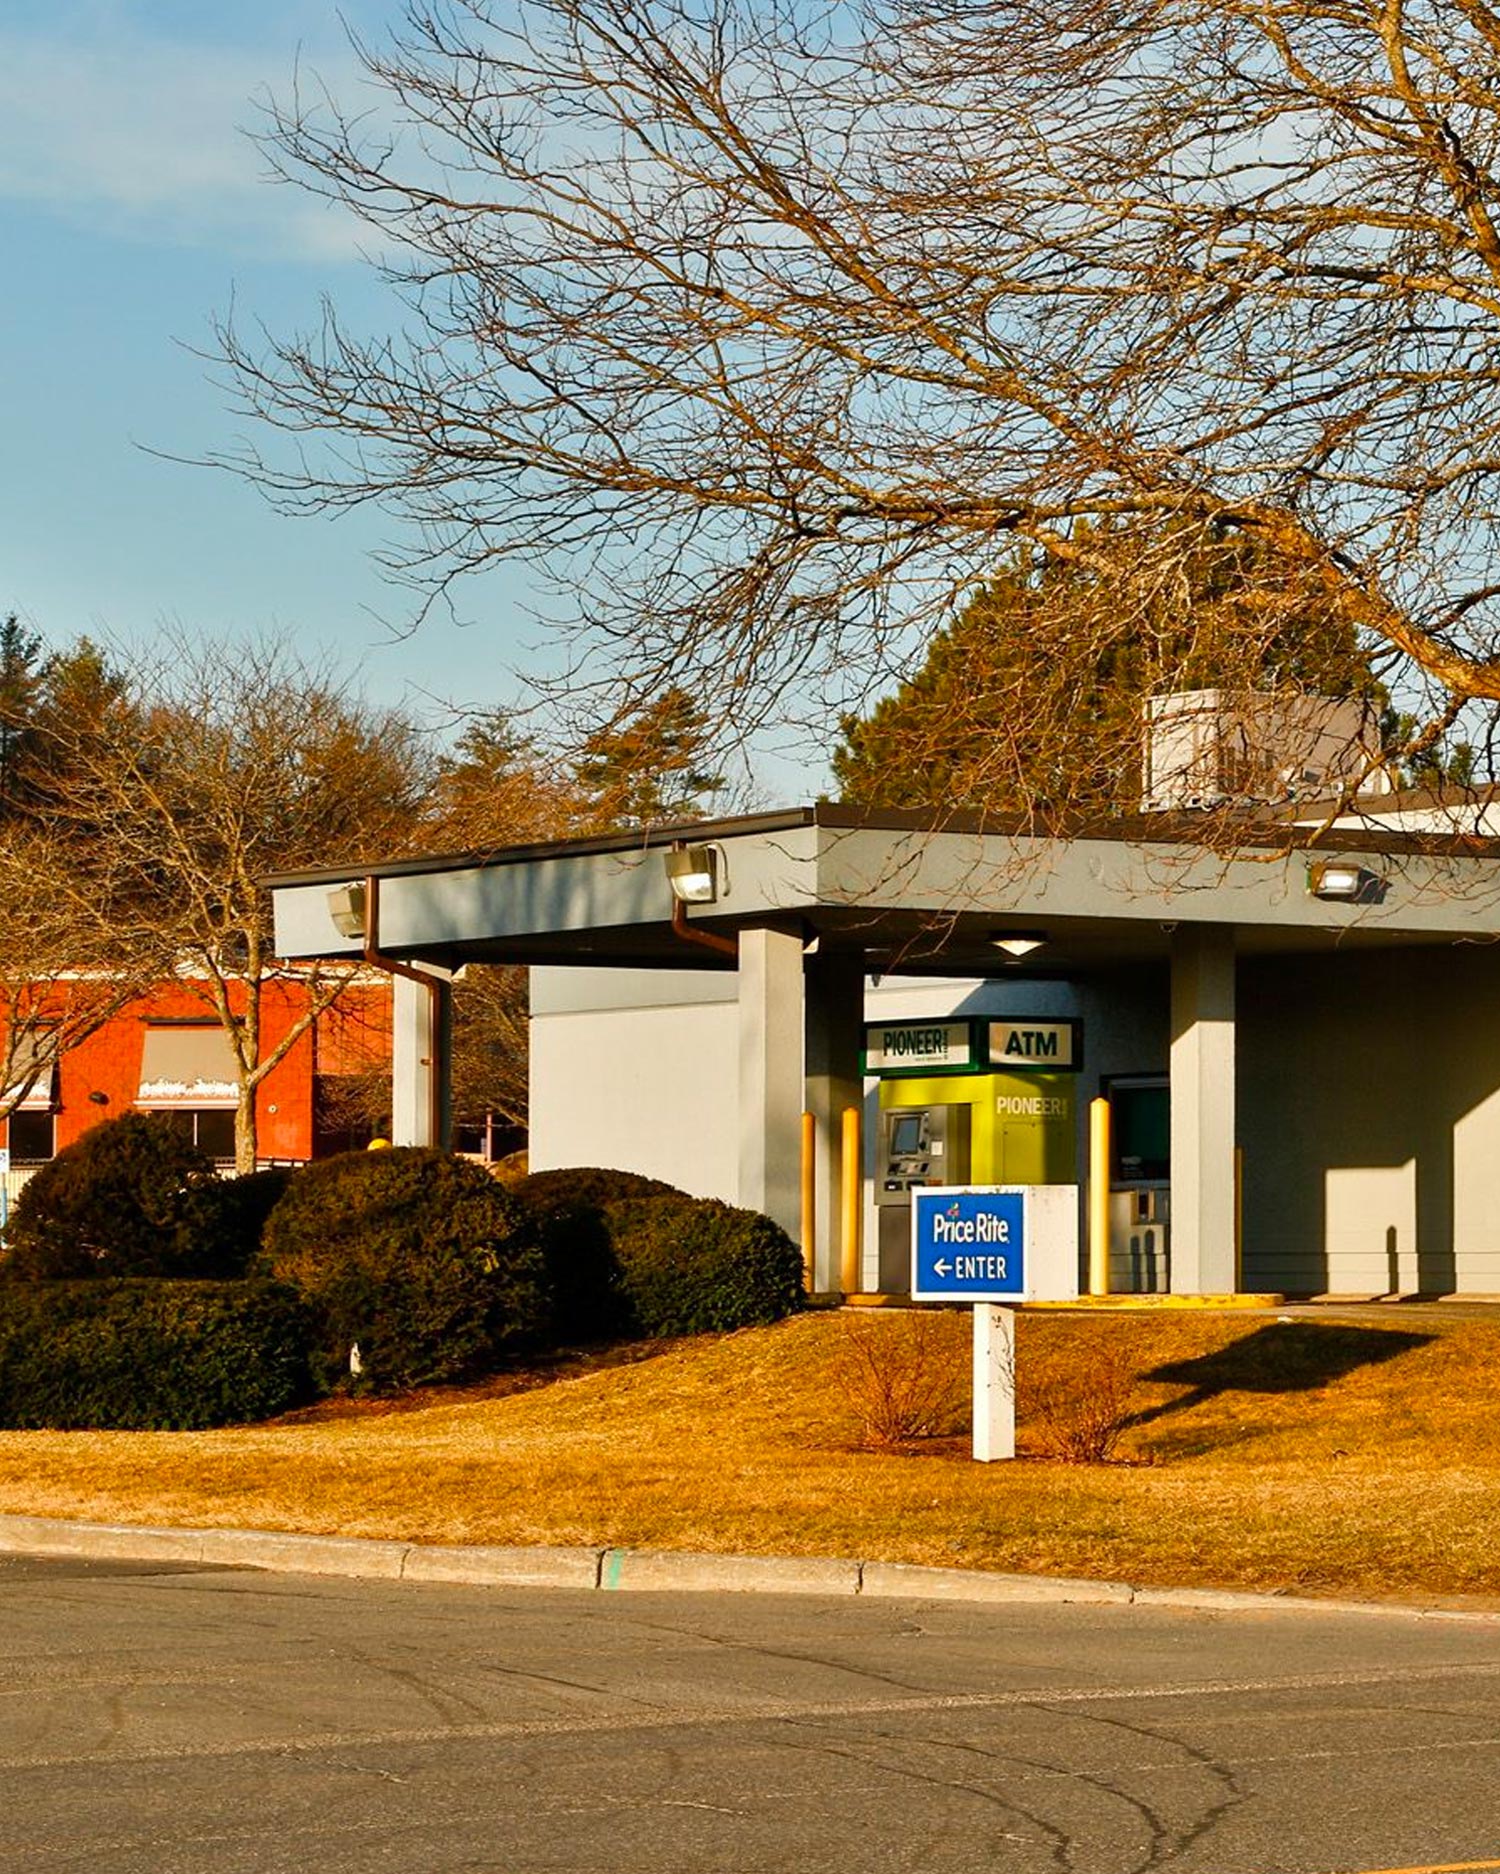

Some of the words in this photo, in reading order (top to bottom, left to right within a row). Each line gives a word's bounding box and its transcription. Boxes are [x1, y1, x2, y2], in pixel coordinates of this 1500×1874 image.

[883, 1028, 942, 1057] PIONEER
[1004, 1030, 1058, 1056] ATM
[997, 1096, 1061, 1116] PIONEER
[955, 1256, 1007, 1279] ENTER
